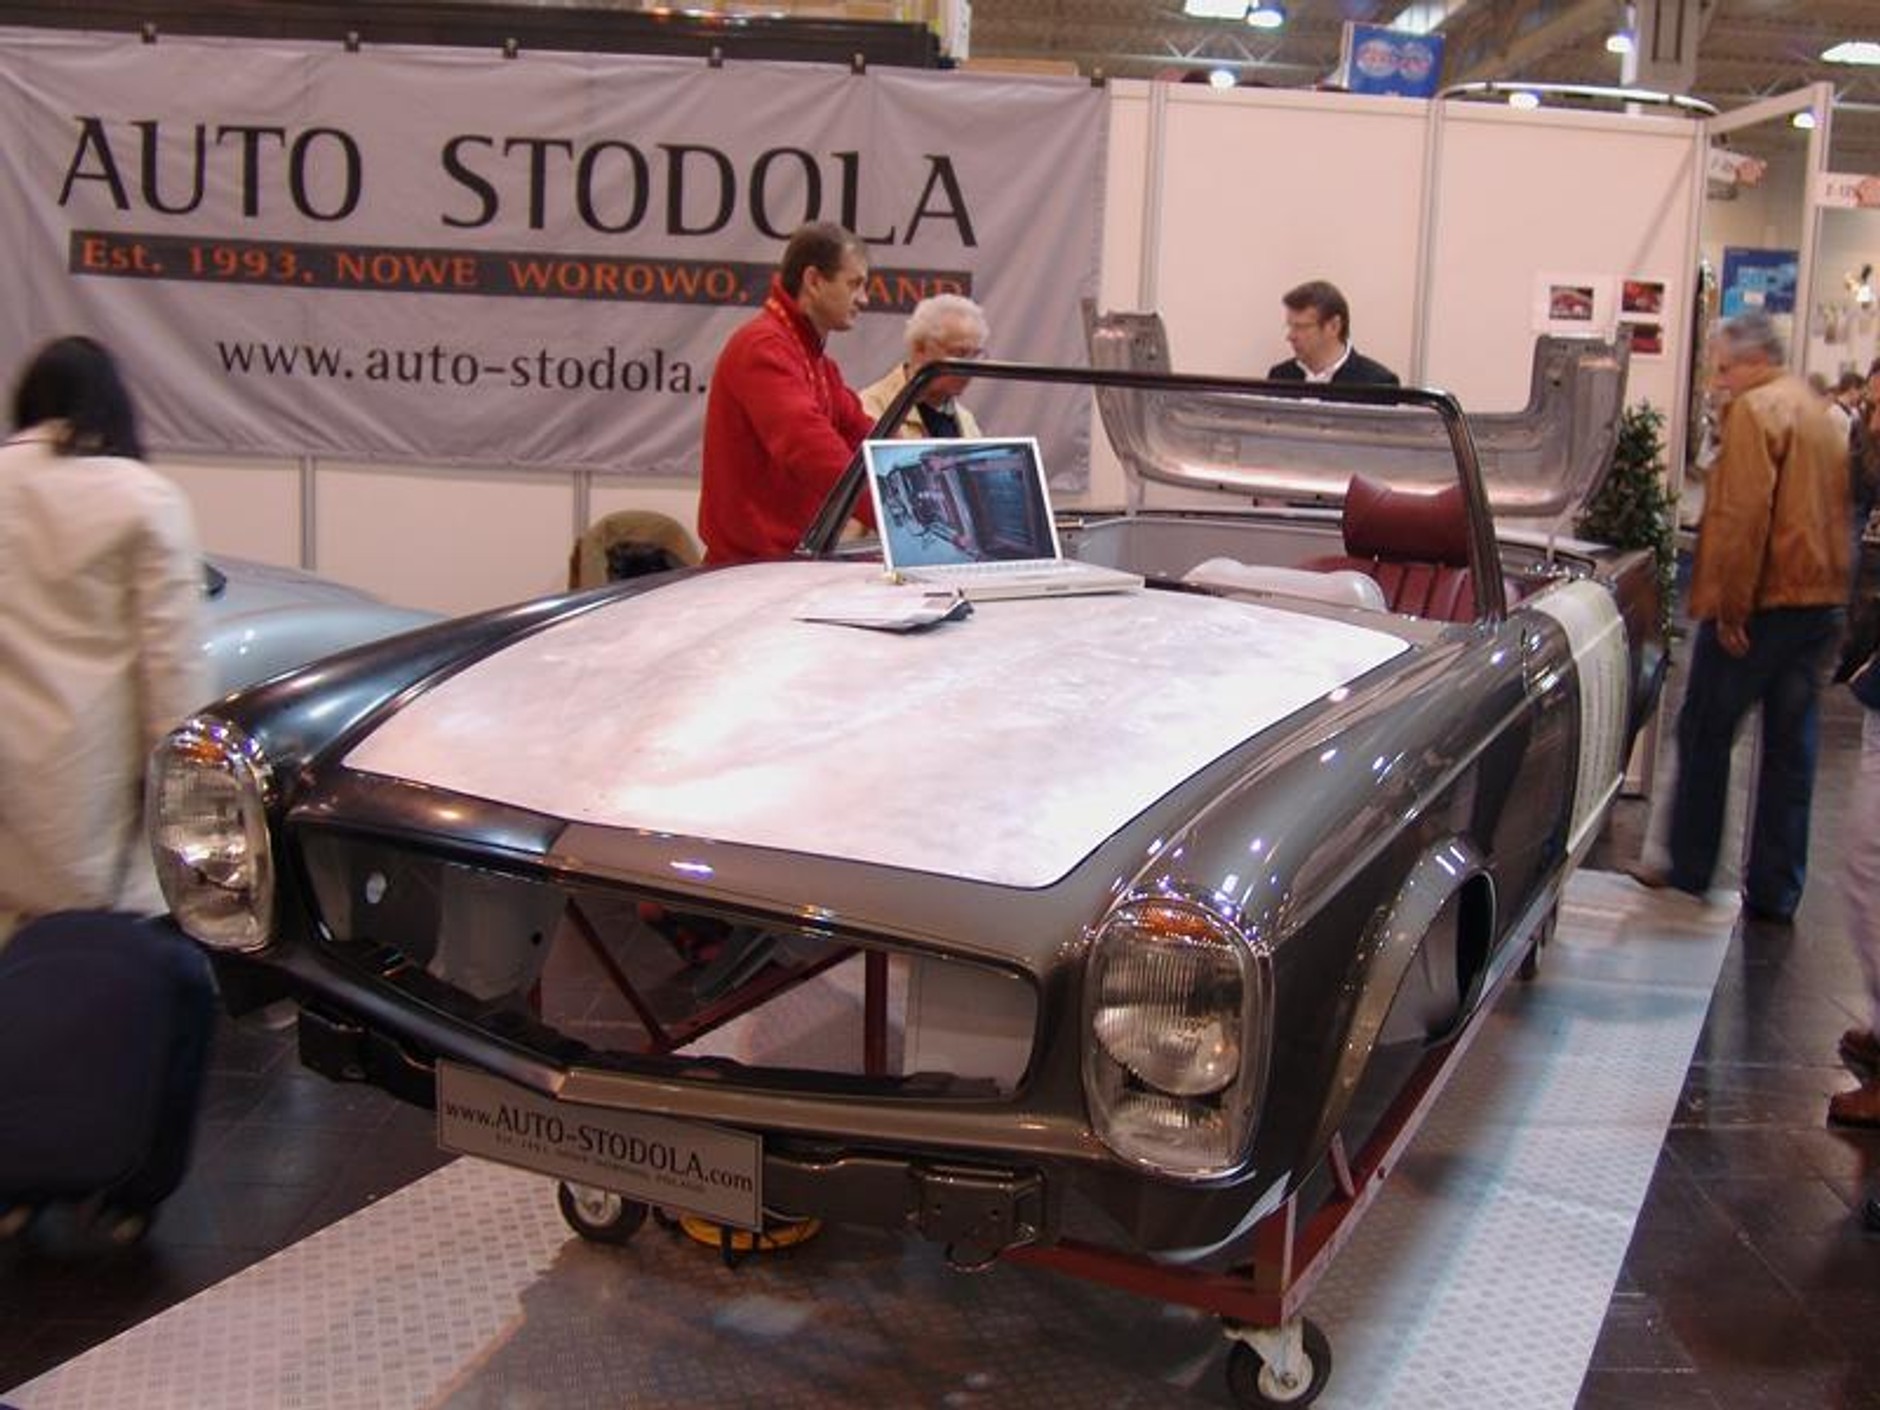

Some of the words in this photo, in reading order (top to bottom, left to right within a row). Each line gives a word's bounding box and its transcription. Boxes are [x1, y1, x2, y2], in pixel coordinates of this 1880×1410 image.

[58, 114, 363, 222] AUTO
[440, 134, 978, 248] STODOLA
[82, 238, 162, 272] Est.
[336, 251, 478, 288] NOWE
[445, 1105, 753, 1193] www.AUTO-STODOLA.com
